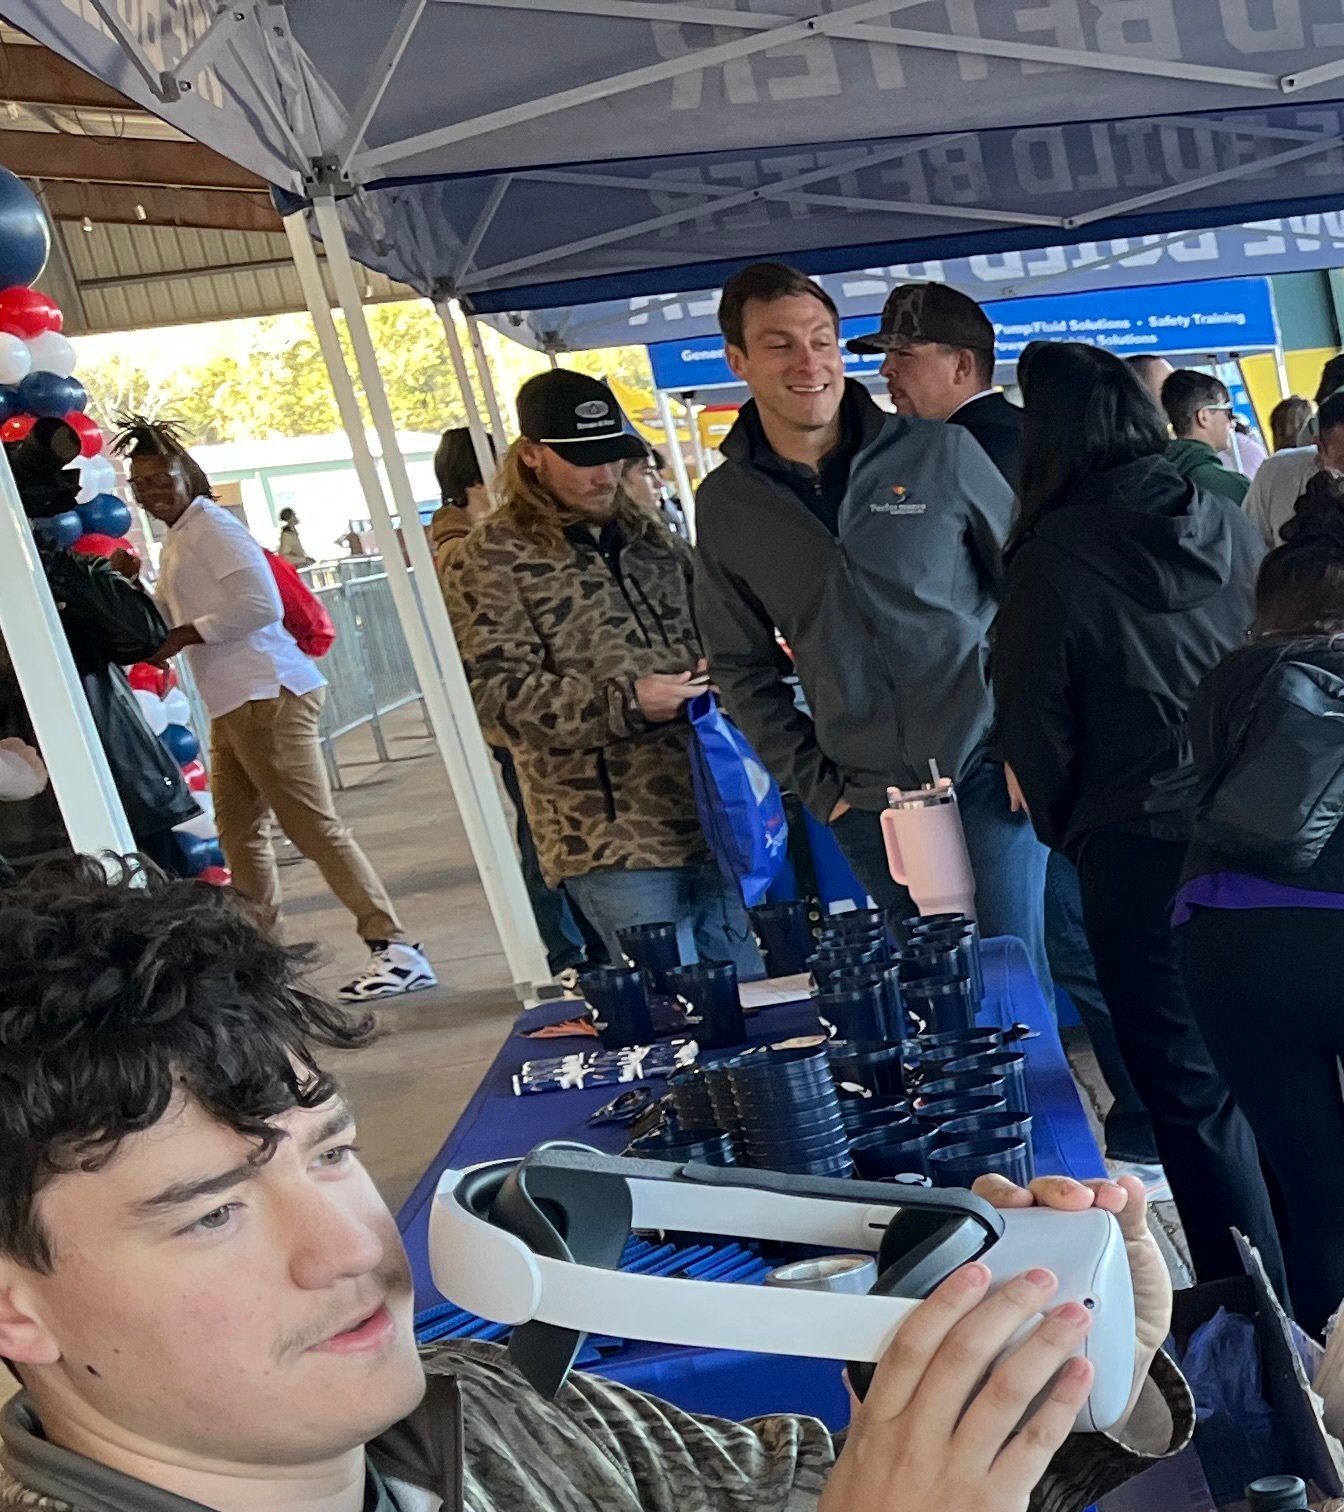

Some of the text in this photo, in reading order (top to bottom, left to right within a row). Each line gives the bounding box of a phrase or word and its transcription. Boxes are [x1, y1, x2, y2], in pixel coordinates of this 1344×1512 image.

[1069, 318, 1131, 332] Solutions
[1148, 314, 1190, 328] Safety
[1191, 312, 1247, 327] Training
